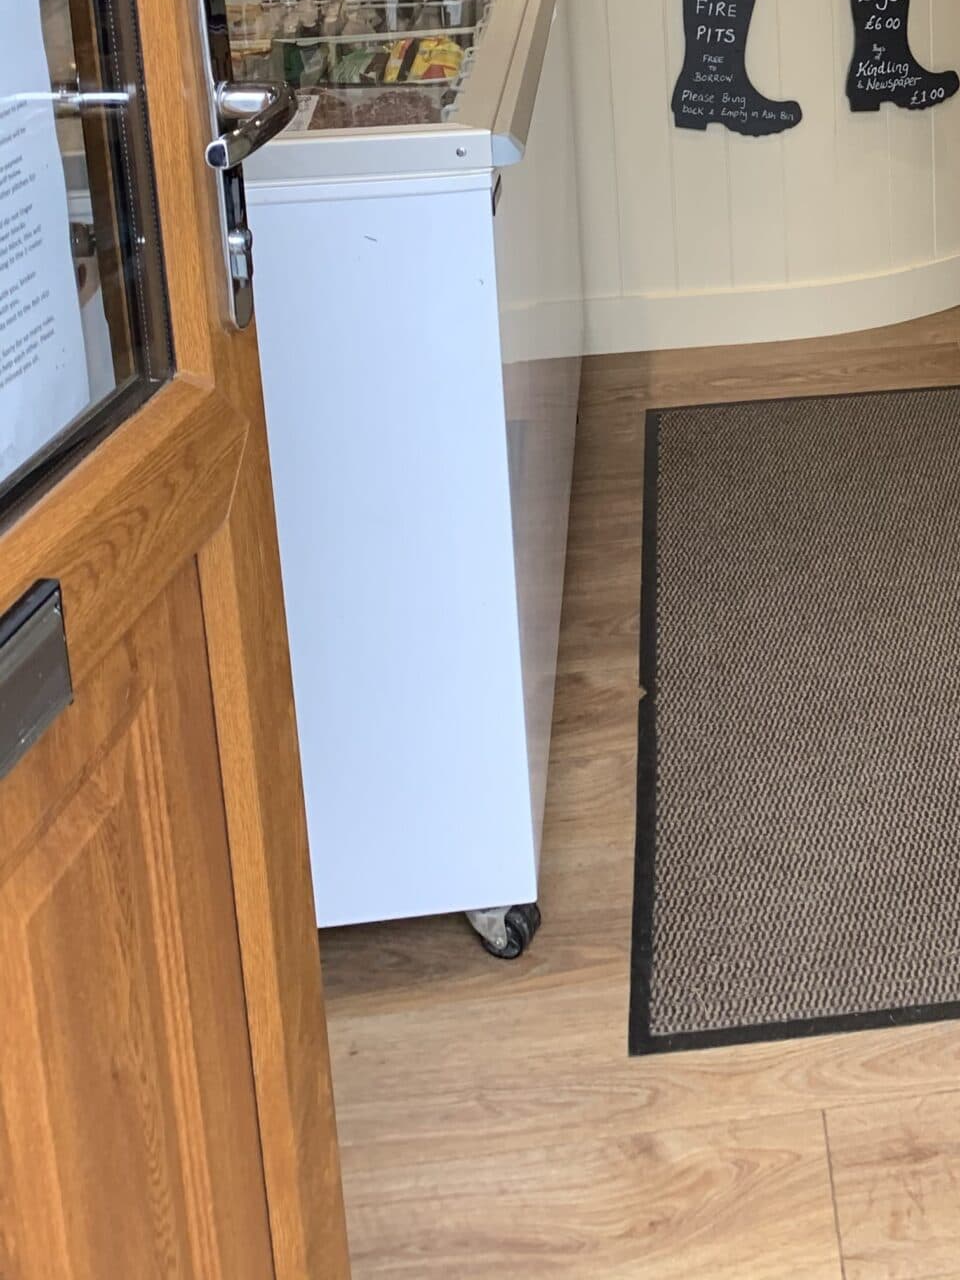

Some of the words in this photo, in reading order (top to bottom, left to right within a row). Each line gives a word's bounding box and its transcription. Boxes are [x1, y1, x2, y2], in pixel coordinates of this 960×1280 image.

[696, 25, 736, 43] PITS
[702, 54, 725, 64] FREE
[693, 73, 734, 82] BORROW
[856, 60, 909, 78] Kindling
[866, 77, 922, 92] Newspaper
[682, 89, 715, 103] Please
[721, 92, 746, 109] Bring
[682, 104, 704, 115] back
[721, 107, 748, 123] Empty
